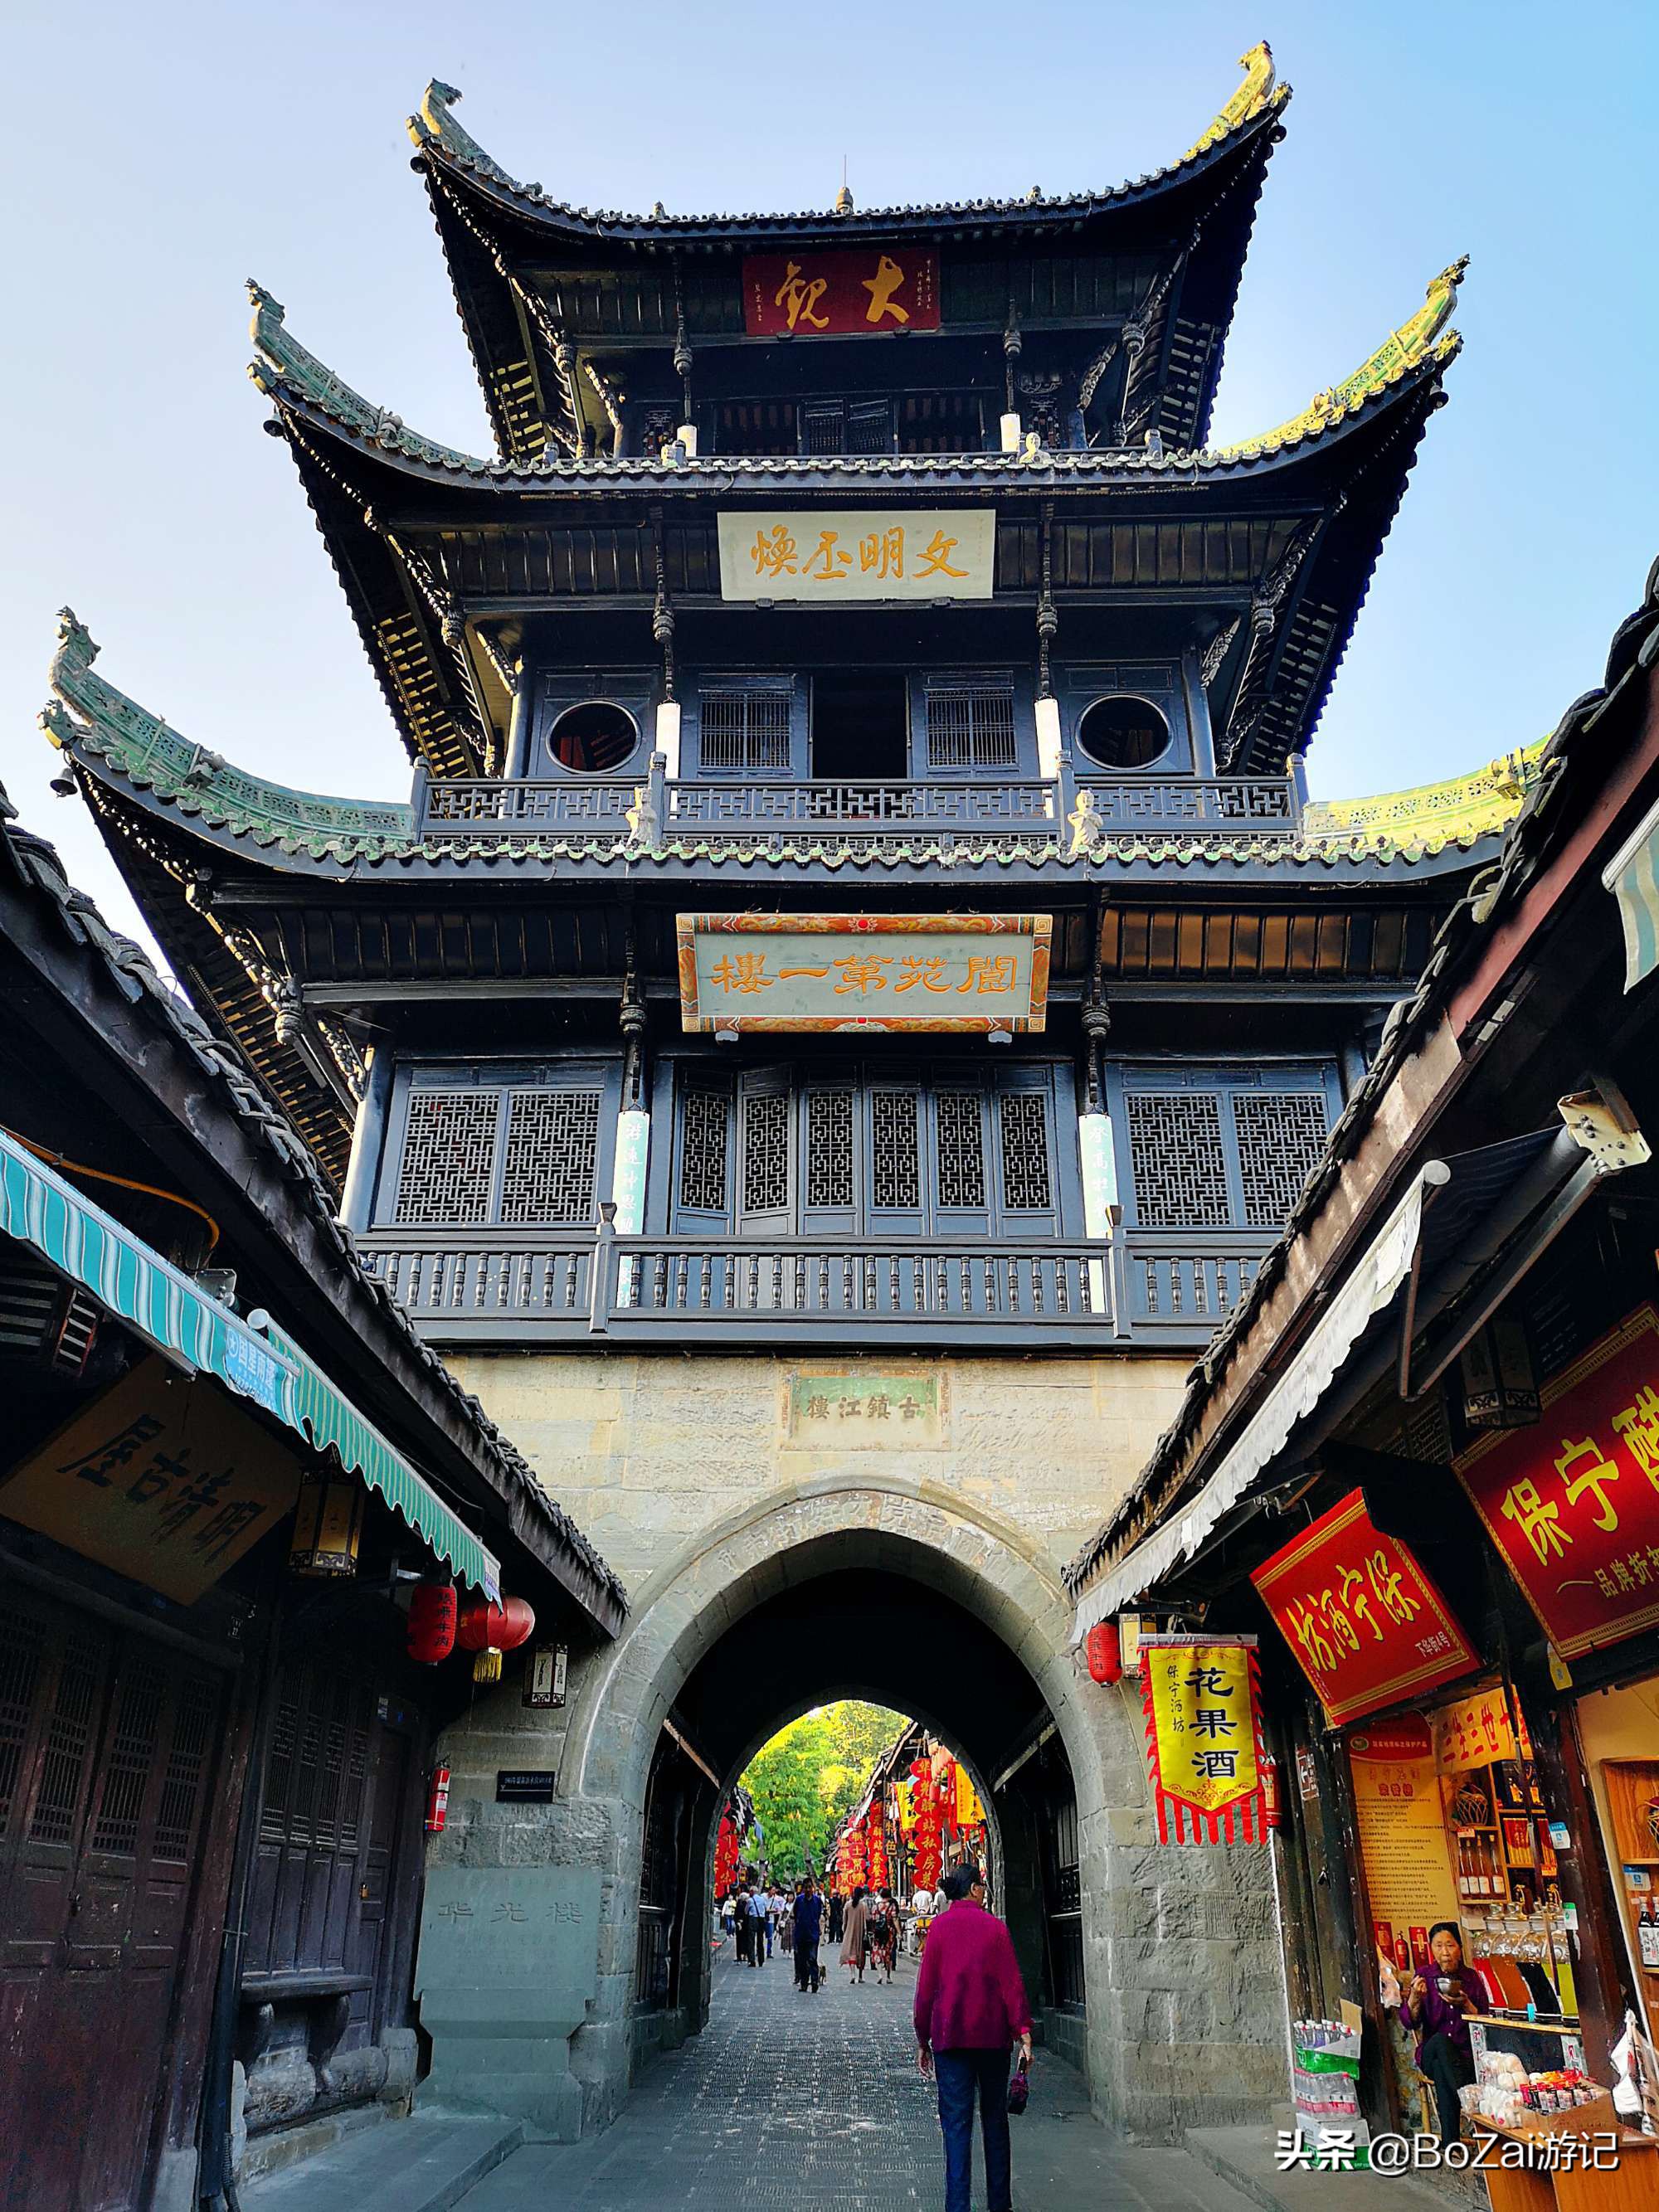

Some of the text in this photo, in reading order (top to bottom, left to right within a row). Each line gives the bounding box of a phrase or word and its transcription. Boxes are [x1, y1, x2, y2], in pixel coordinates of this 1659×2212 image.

[1185, 1667, 1239, 1777] 花果酒
[438, 1902, 583, 1924] 华光楼
